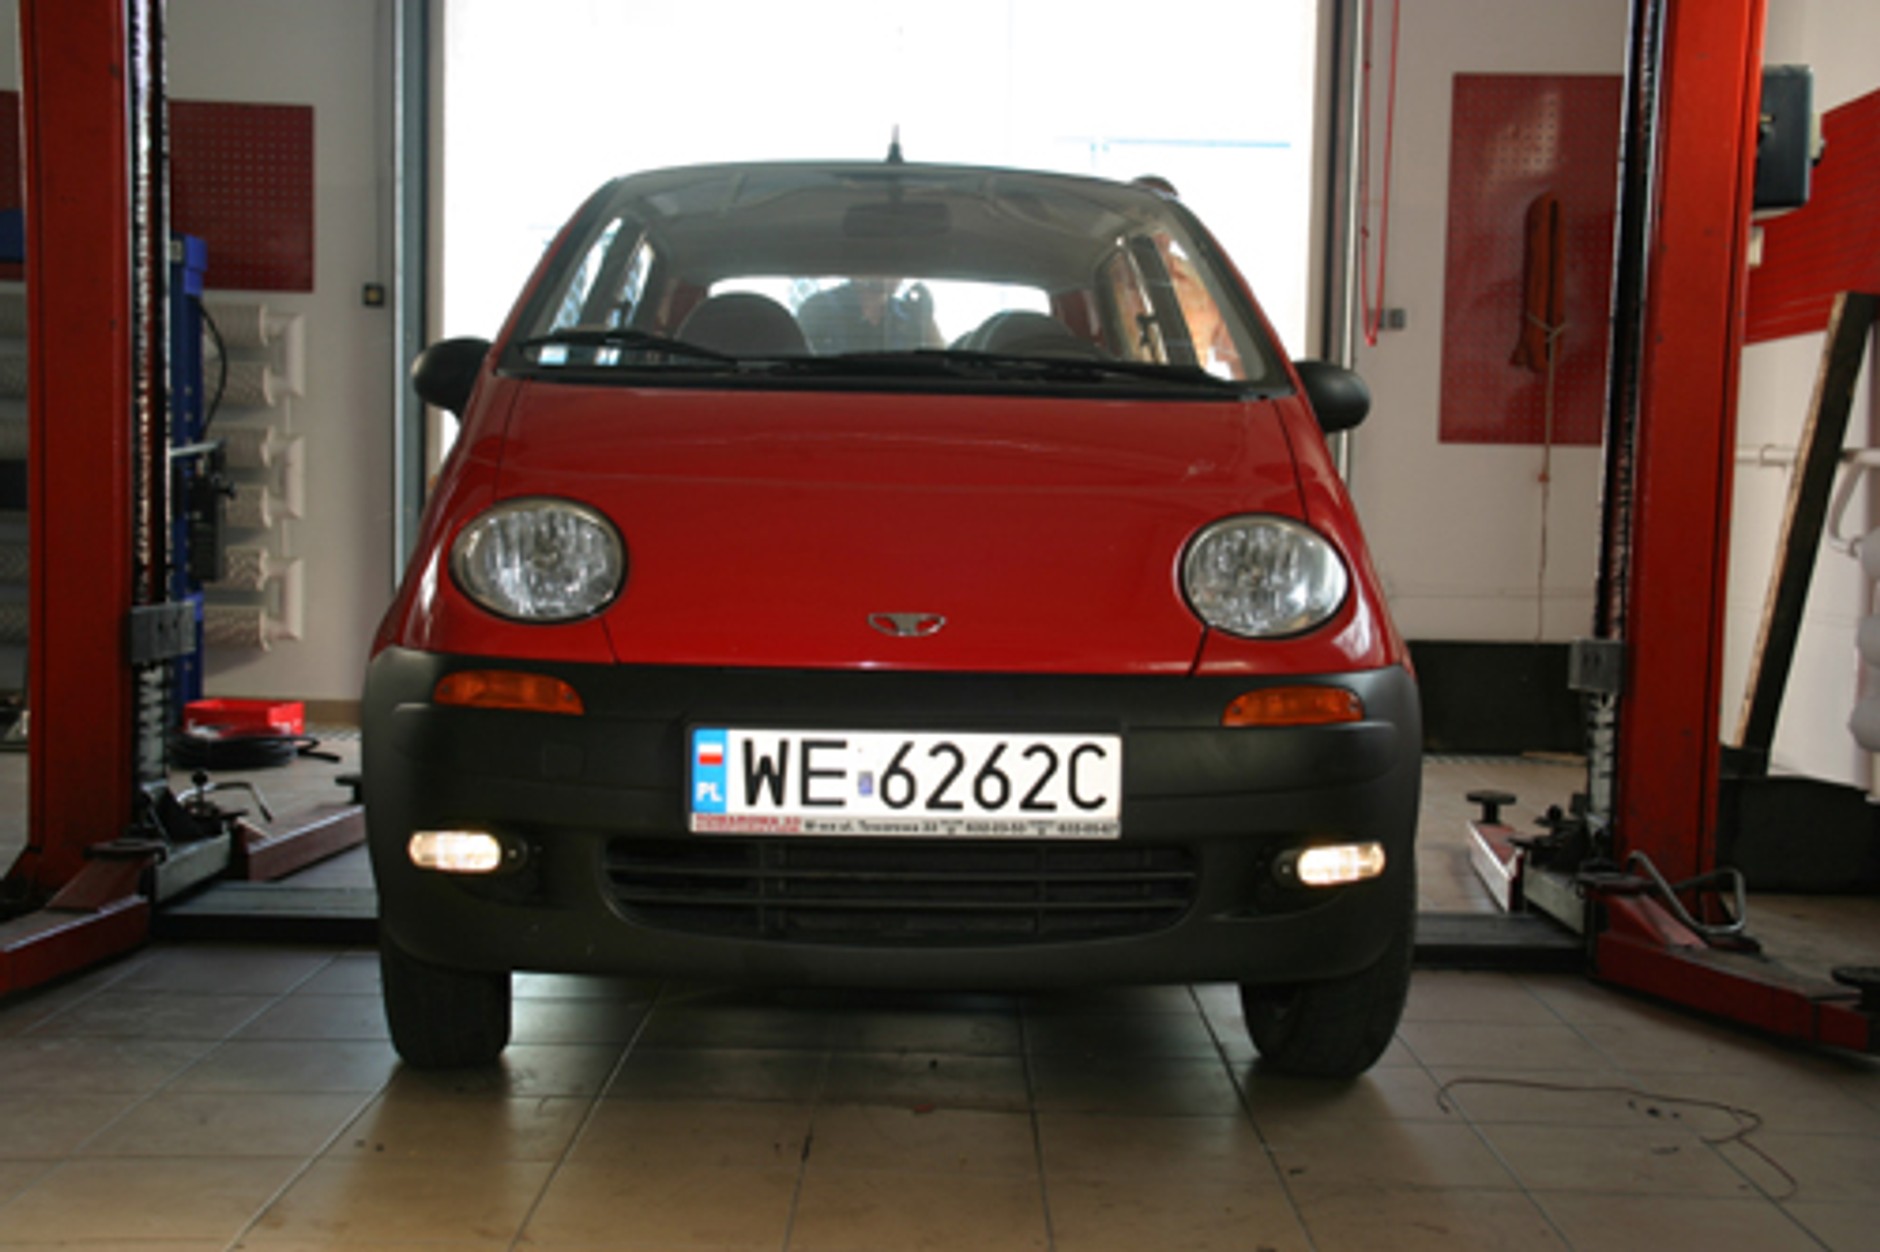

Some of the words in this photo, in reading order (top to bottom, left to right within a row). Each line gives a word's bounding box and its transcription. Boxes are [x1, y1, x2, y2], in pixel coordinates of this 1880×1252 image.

[696, 781, 722, 802] PL
[743, 738, 847, 808] WE
[880, 741, 1107, 811] 6262C
